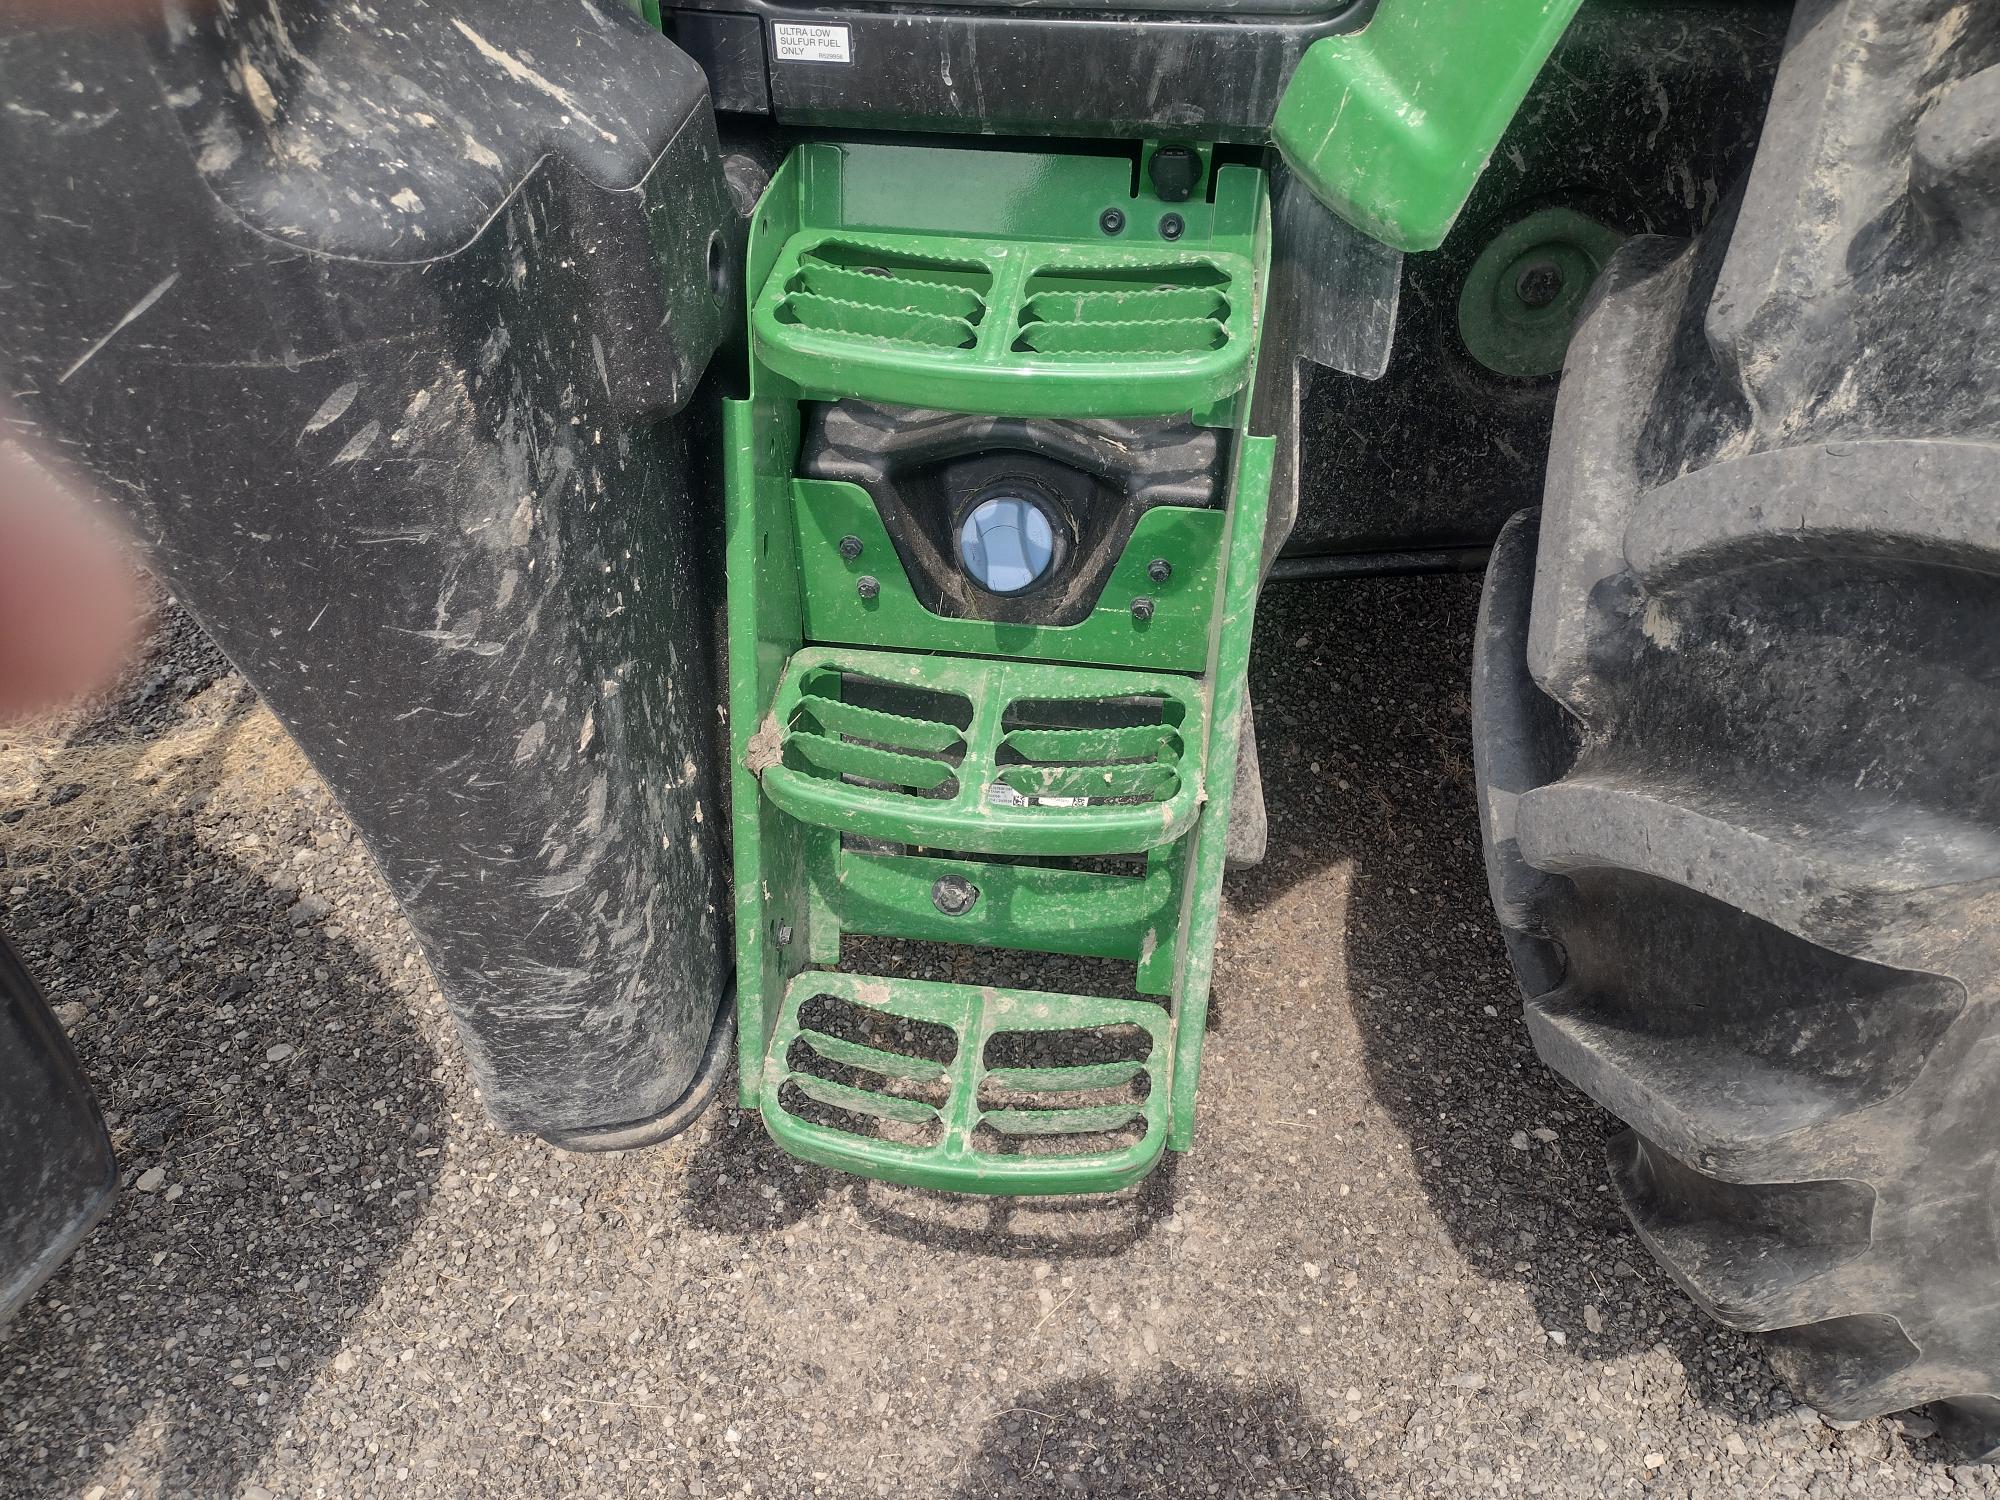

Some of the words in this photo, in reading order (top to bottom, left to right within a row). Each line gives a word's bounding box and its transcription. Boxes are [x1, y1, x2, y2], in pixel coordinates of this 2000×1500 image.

[779, 27, 808, 36] ULTRA
[810, 29, 831, 37] LOW
[780, 37, 816, 46] SULFUR
[818, 39, 841, 48] FUEL
[781, 46, 805, 55] ONLY
